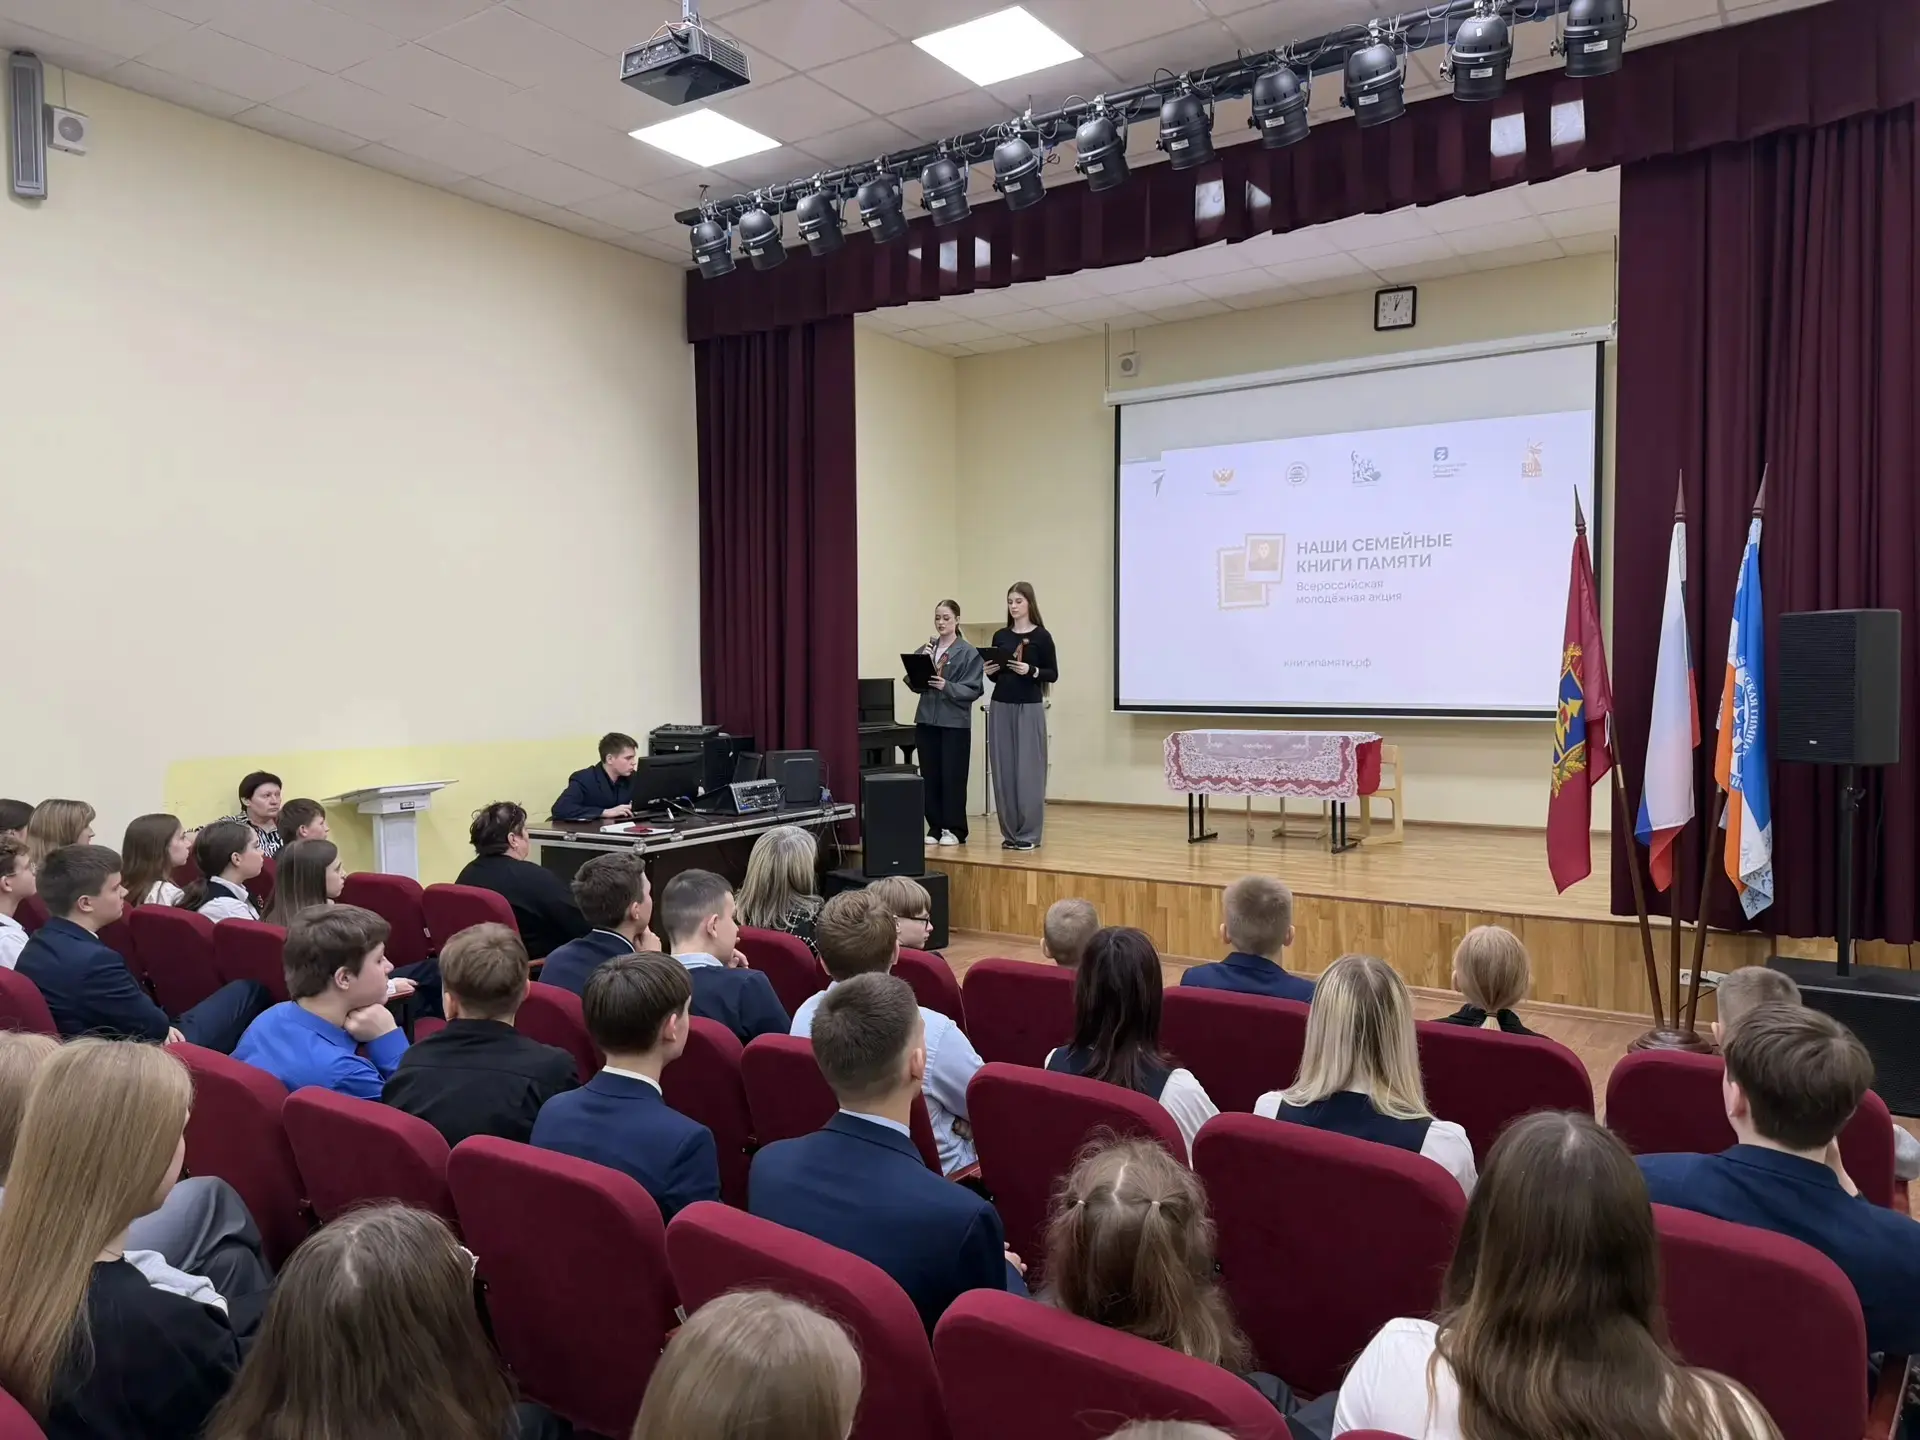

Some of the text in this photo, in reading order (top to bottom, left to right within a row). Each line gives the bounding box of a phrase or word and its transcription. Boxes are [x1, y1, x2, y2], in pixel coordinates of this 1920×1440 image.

[1297, 532, 1452, 554] НАШИ СЕМЕЙНЫЕ
[1296, 553, 1432, 573] КНИГИ ПАМЯТИ
[1296, 579, 1384, 592] Всероссийская
[1296, 591, 1402, 604] молодёжная акция
